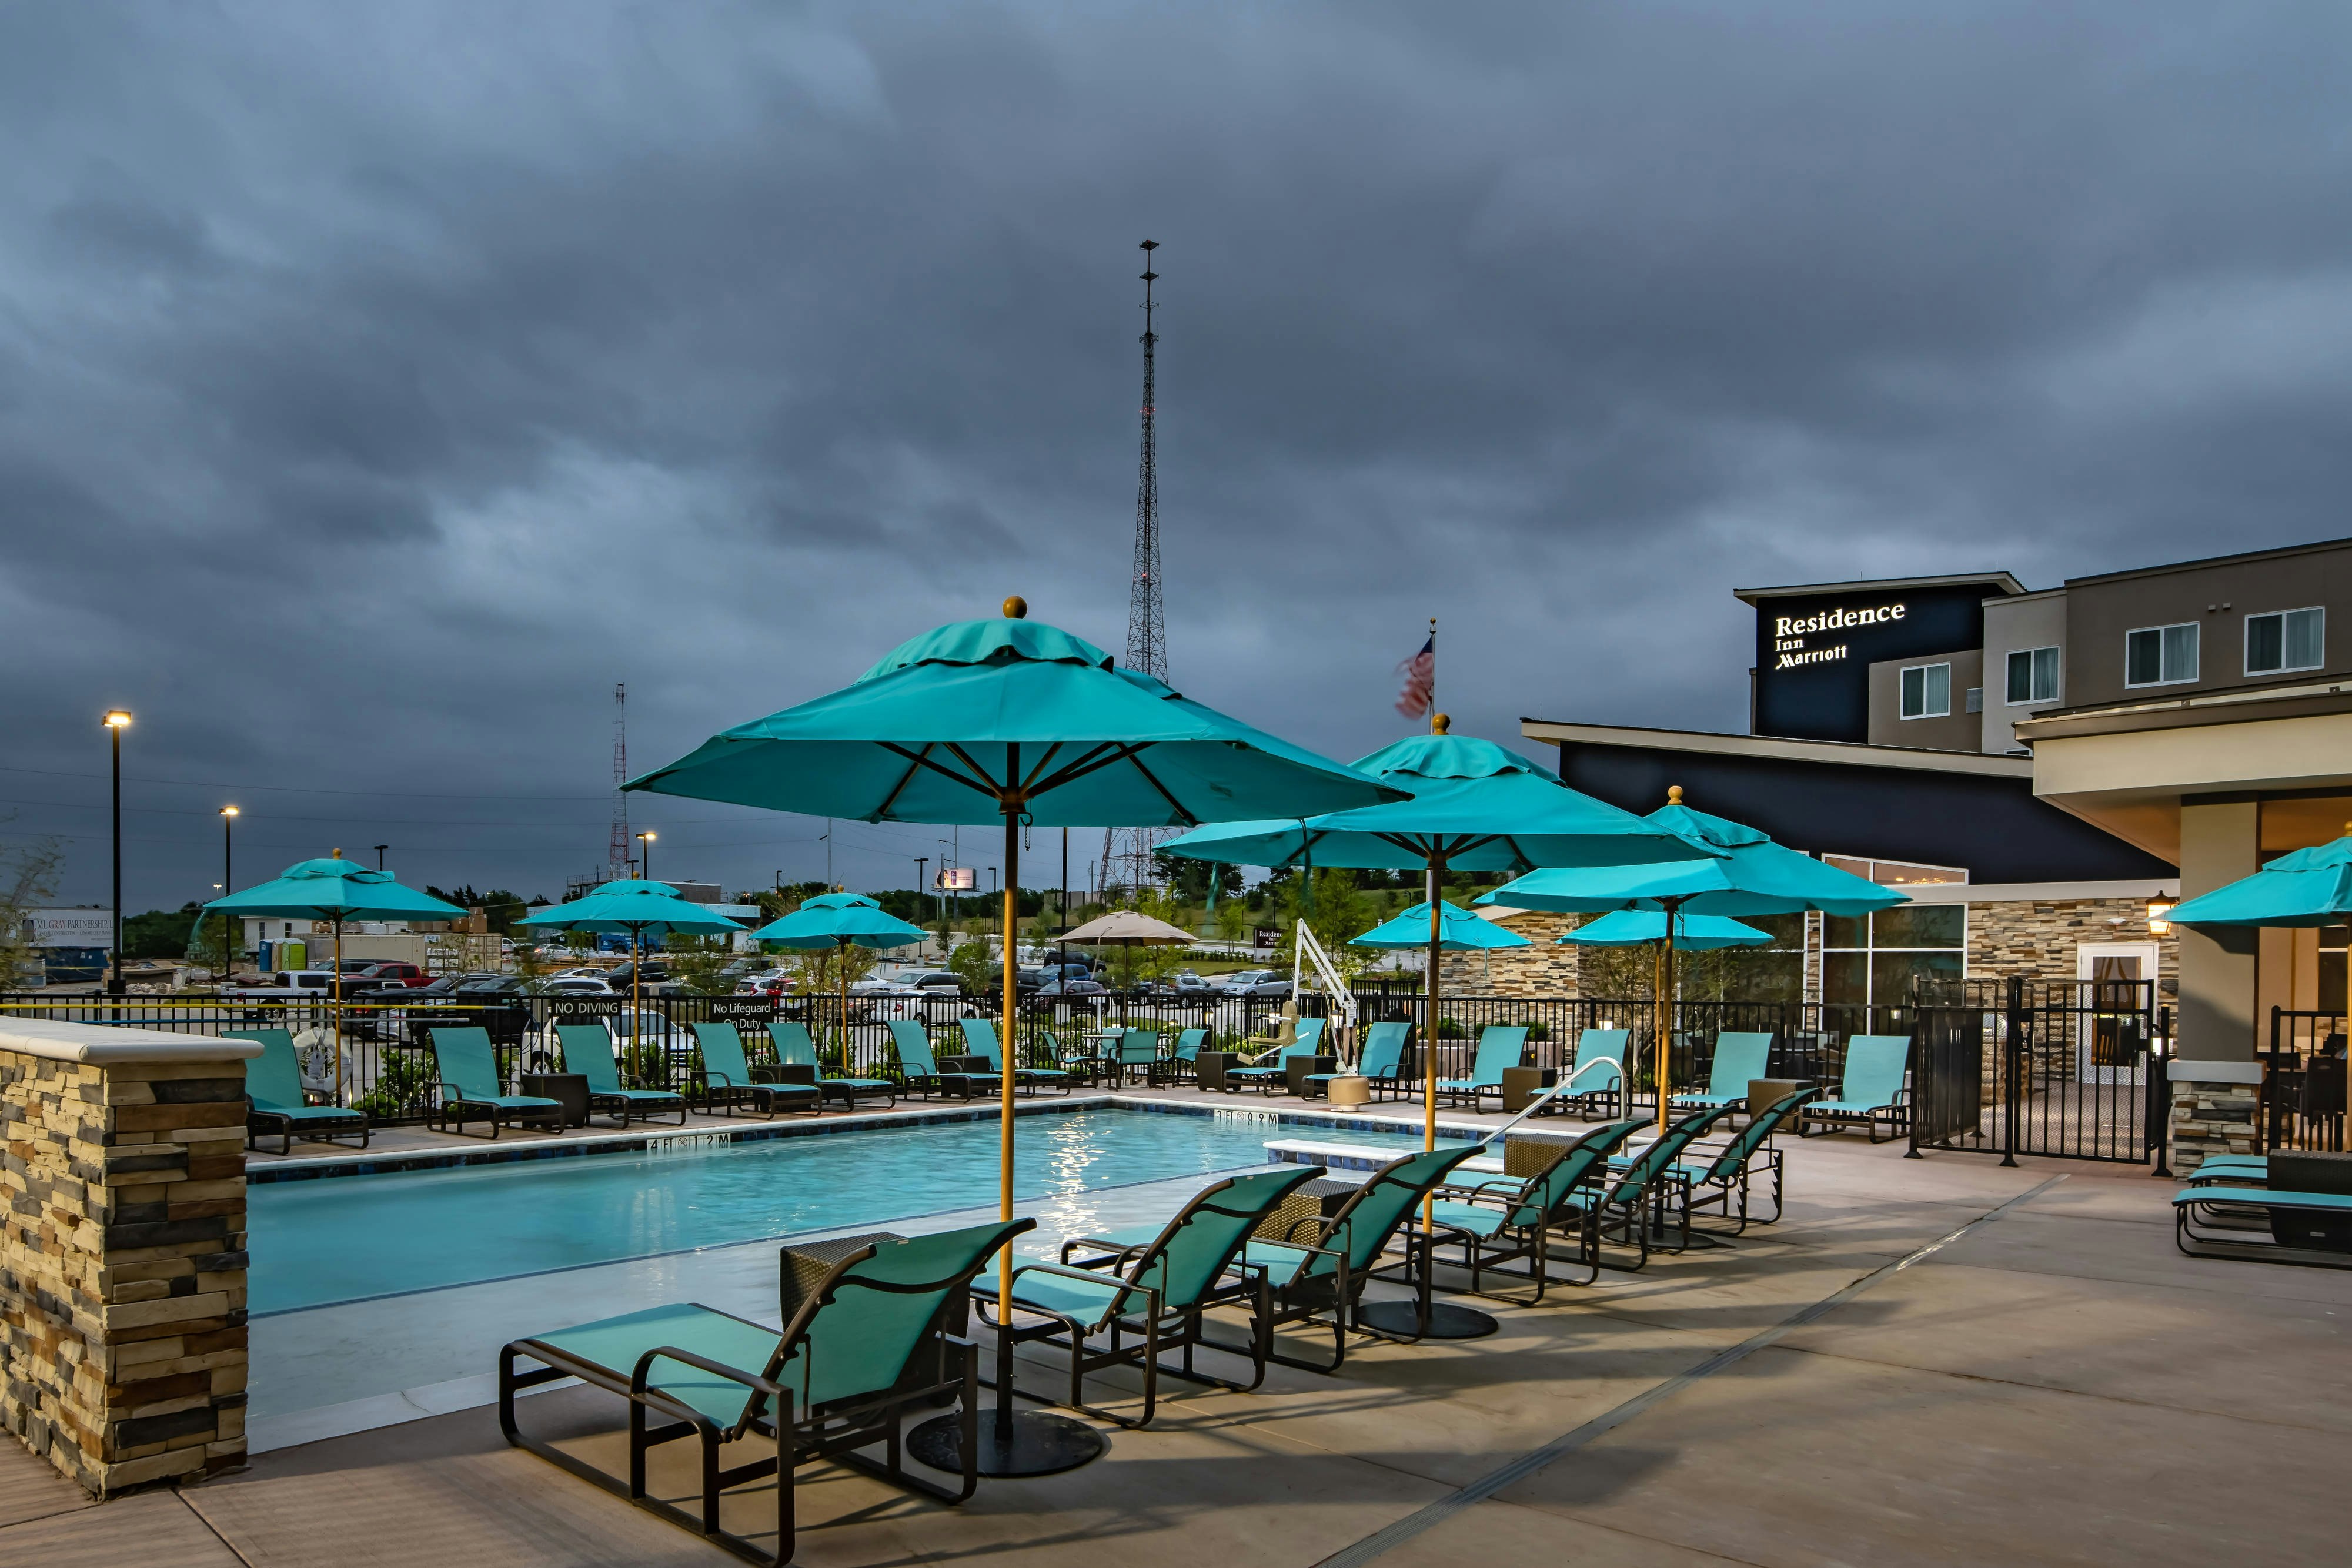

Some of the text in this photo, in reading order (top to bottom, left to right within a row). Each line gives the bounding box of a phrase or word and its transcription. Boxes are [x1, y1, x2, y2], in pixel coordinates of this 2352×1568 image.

[1775, 604, 1905, 637] Residence
[1775, 639, 1803, 651] Inn
[1775, 645, 1847, 670] Marriott
[37, 919, 47, 929] ML
[49, 919, 65, 929] GRAY
[556, 1002, 618, 1014] NO DIVING
[714, 1002, 770, 1015] No Lifeguard
[740, 1018, 761, 1030] Duty
[1226, 1111, 1234, 1119] FT
[1268, 1114, 1277, 1124] M
[650, 1139, 658, 1149] 4
[663, 1138, 674, 1148] FT
[719, 1134, 729, 1144] M
